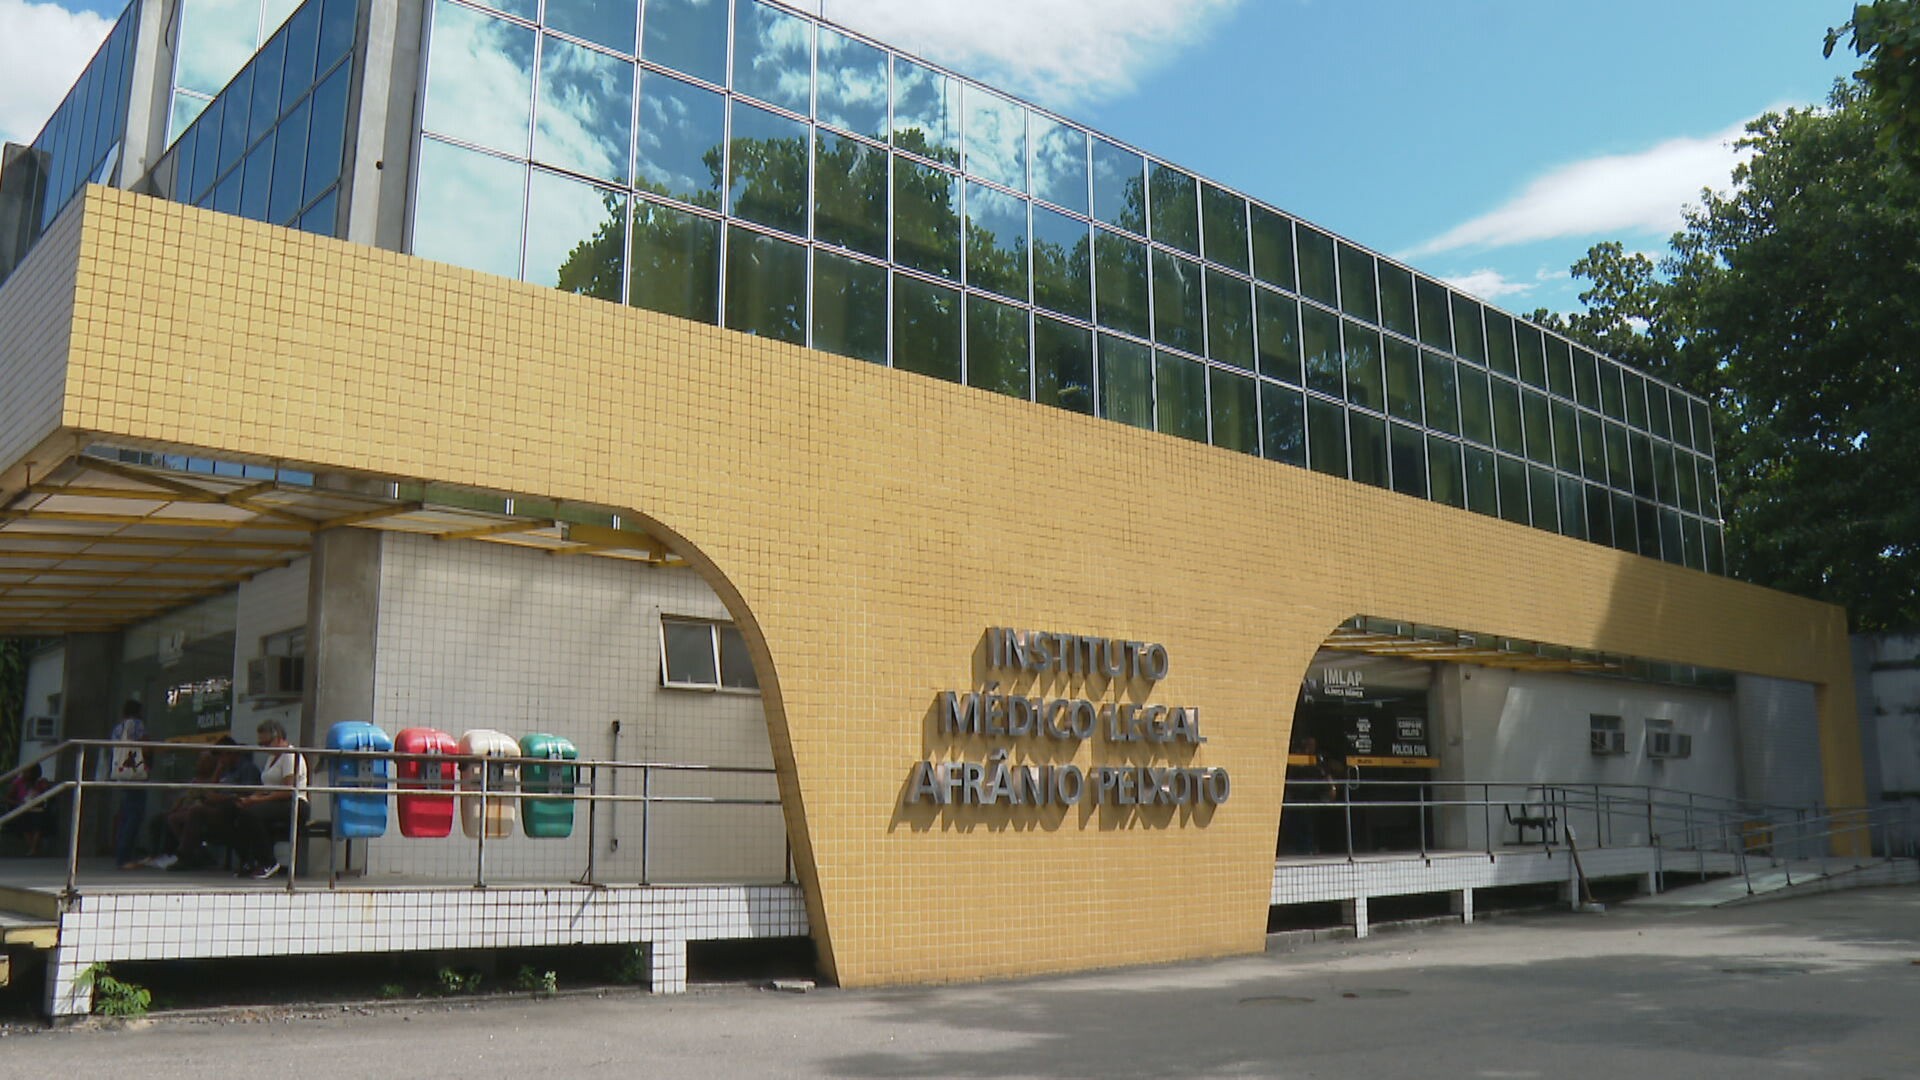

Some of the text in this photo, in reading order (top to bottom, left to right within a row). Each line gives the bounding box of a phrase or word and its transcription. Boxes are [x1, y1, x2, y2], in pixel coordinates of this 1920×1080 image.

[986, 627, 1168, 680] INSTITUTO
[1323, 668, 1363, 686] IMLAP
[937, 681, 1207, 743] MÉDICO LEGAL
[904, 749, 1230, 804] AFRÂNIO PEIXOTO
